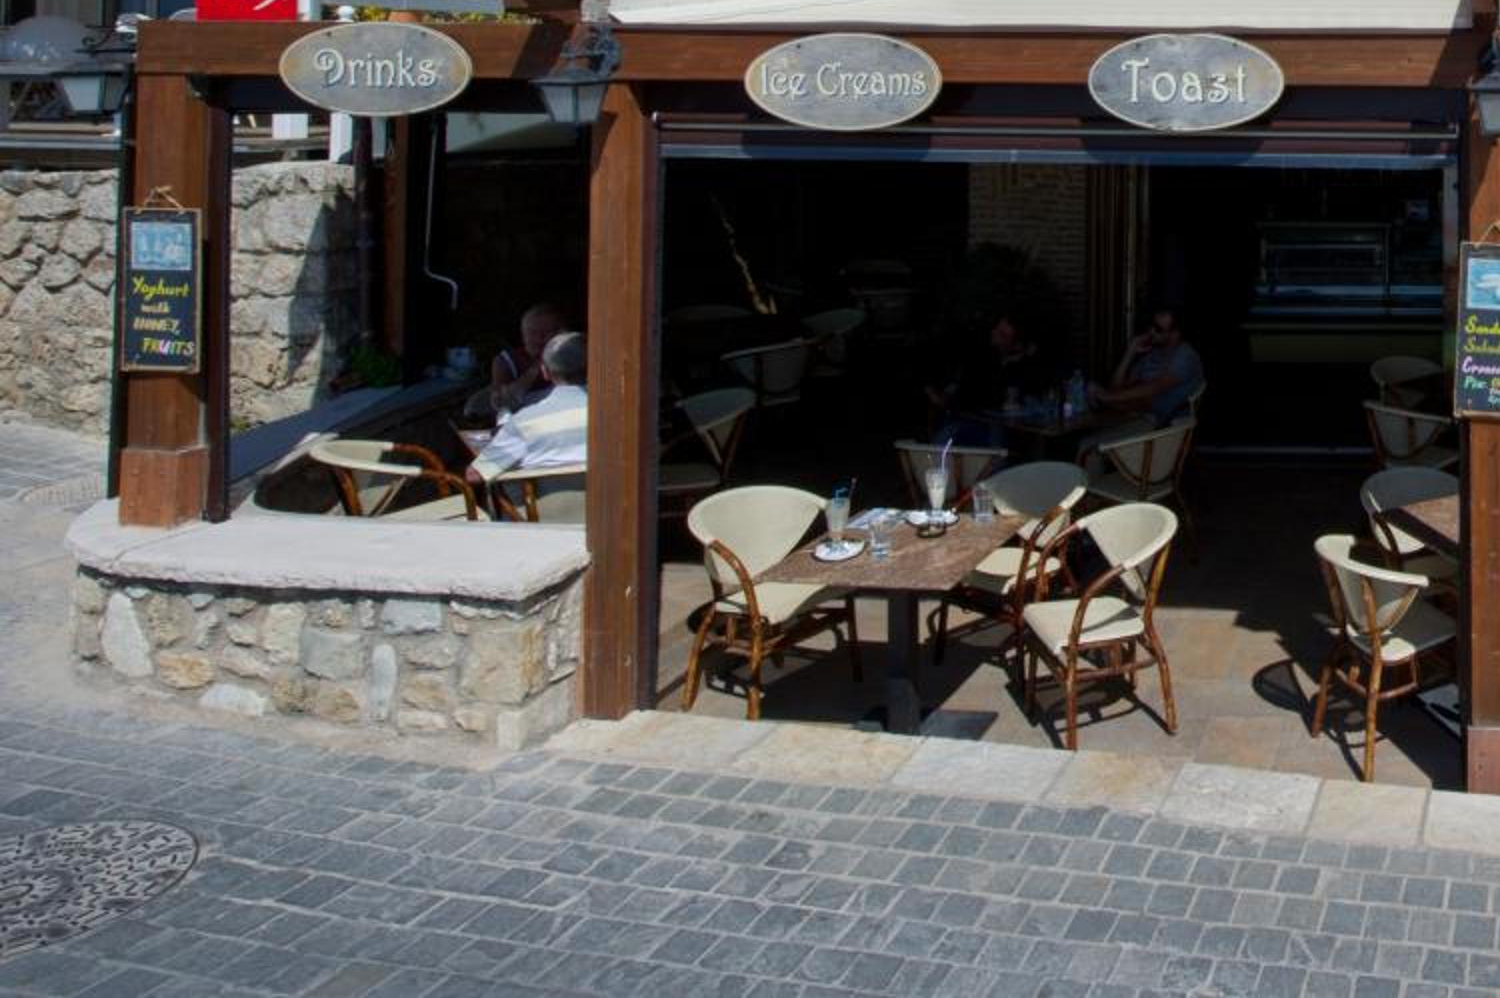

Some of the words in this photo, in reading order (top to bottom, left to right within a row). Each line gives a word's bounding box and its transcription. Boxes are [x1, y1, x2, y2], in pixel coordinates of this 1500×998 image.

[313, 48, 438, 88] Drinks
[760, 62, 803, 101] Ice
[816, 61, 927, 100] Creams
[1121, 58, 1248, 104] Toast
[132, 276, 190, 300] Yoghurt
[142, 337, 195, 356] FRUITS
